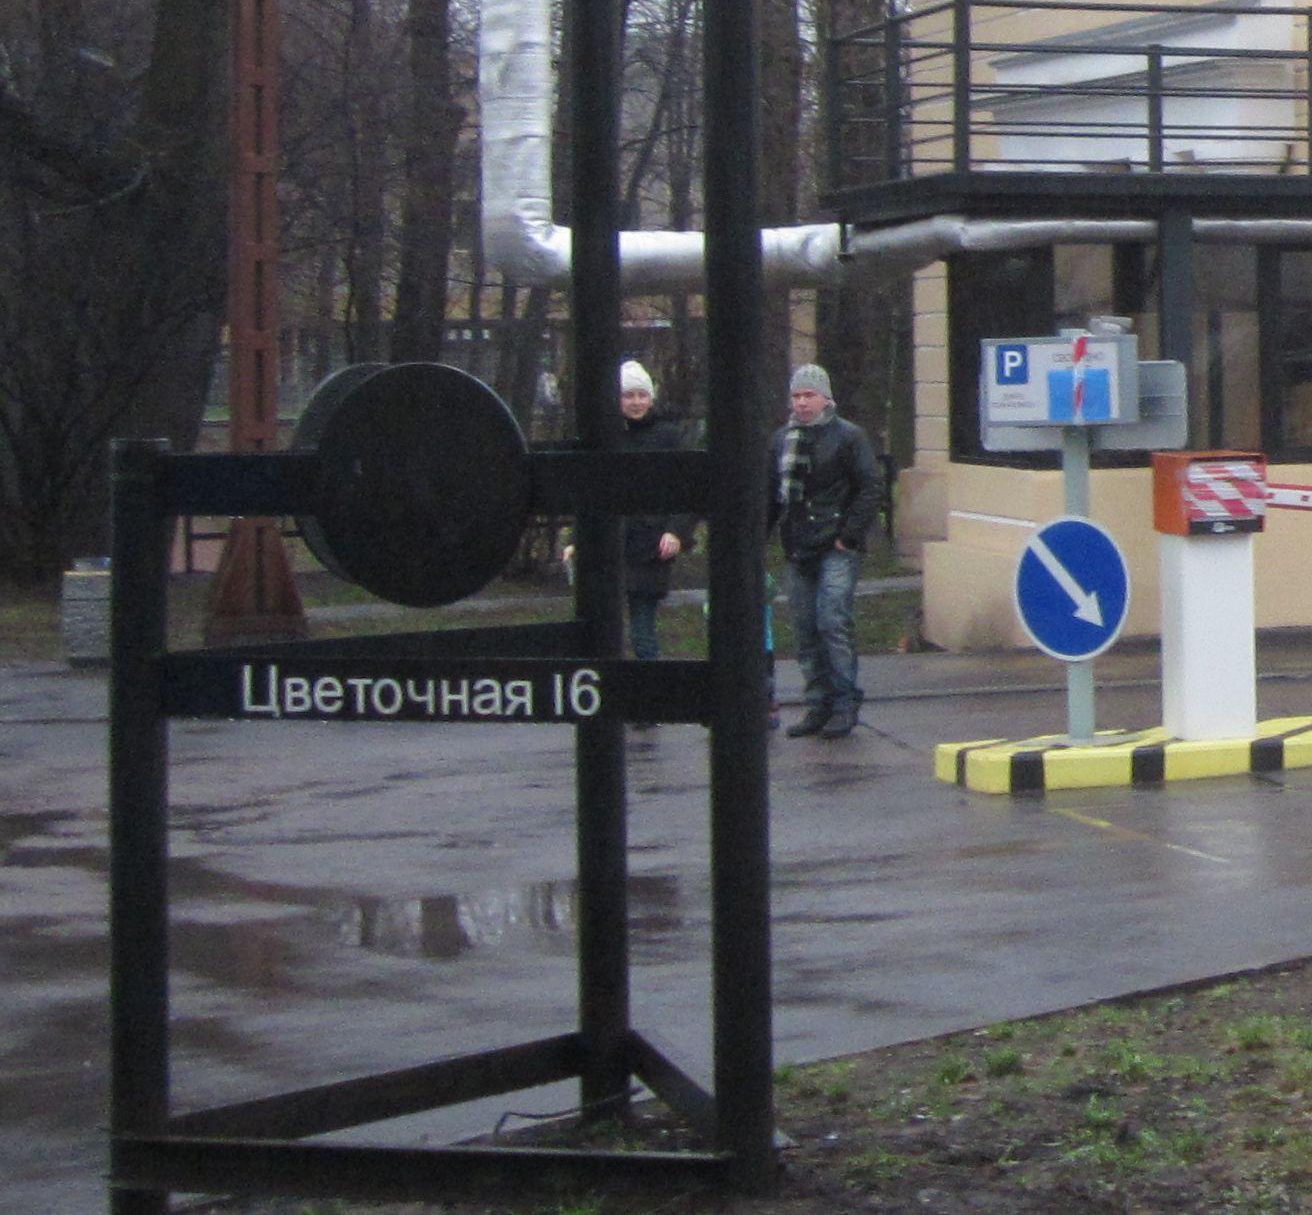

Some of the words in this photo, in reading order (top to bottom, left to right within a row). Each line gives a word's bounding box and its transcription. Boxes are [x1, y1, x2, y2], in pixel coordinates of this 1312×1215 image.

[1004, 350, 1024, 377] P
[241, 664, 533, 719] Цветочная
[554, 668, 602, 717] 16
